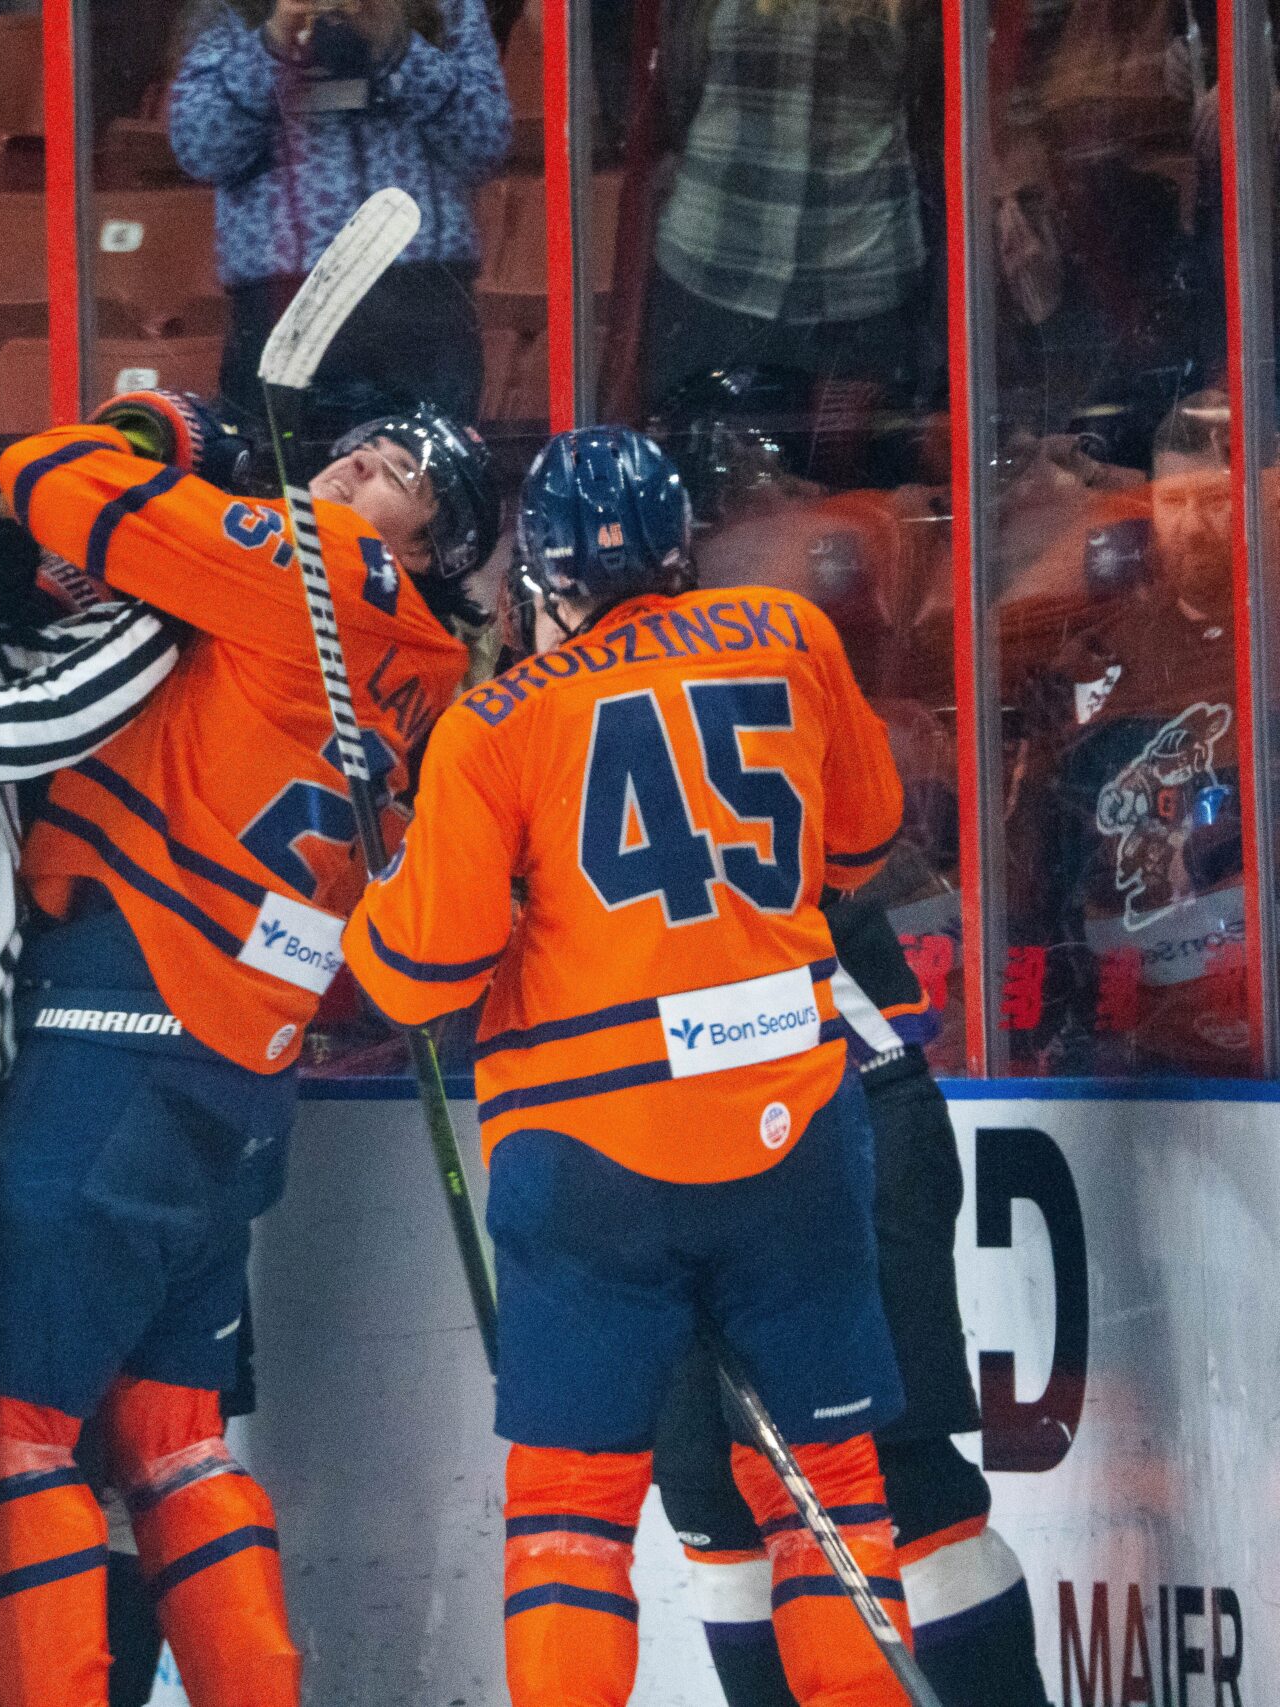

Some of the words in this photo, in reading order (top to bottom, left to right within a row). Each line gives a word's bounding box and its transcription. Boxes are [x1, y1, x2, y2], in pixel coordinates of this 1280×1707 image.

[283, 482, 370, 782] WARRIOR
[463, 600, 809, 728] BRODZINSKI
[578, 676, 804, 929] 45
[283, 935, 322, 969] Bon
[34, 1007, 184, 1036] WARRIOR
[709, 1021, 756, 1046] Bon
[757, 1005, 818, 1036] Secours
[1058, 1580, 1244, 1707] MAIER
